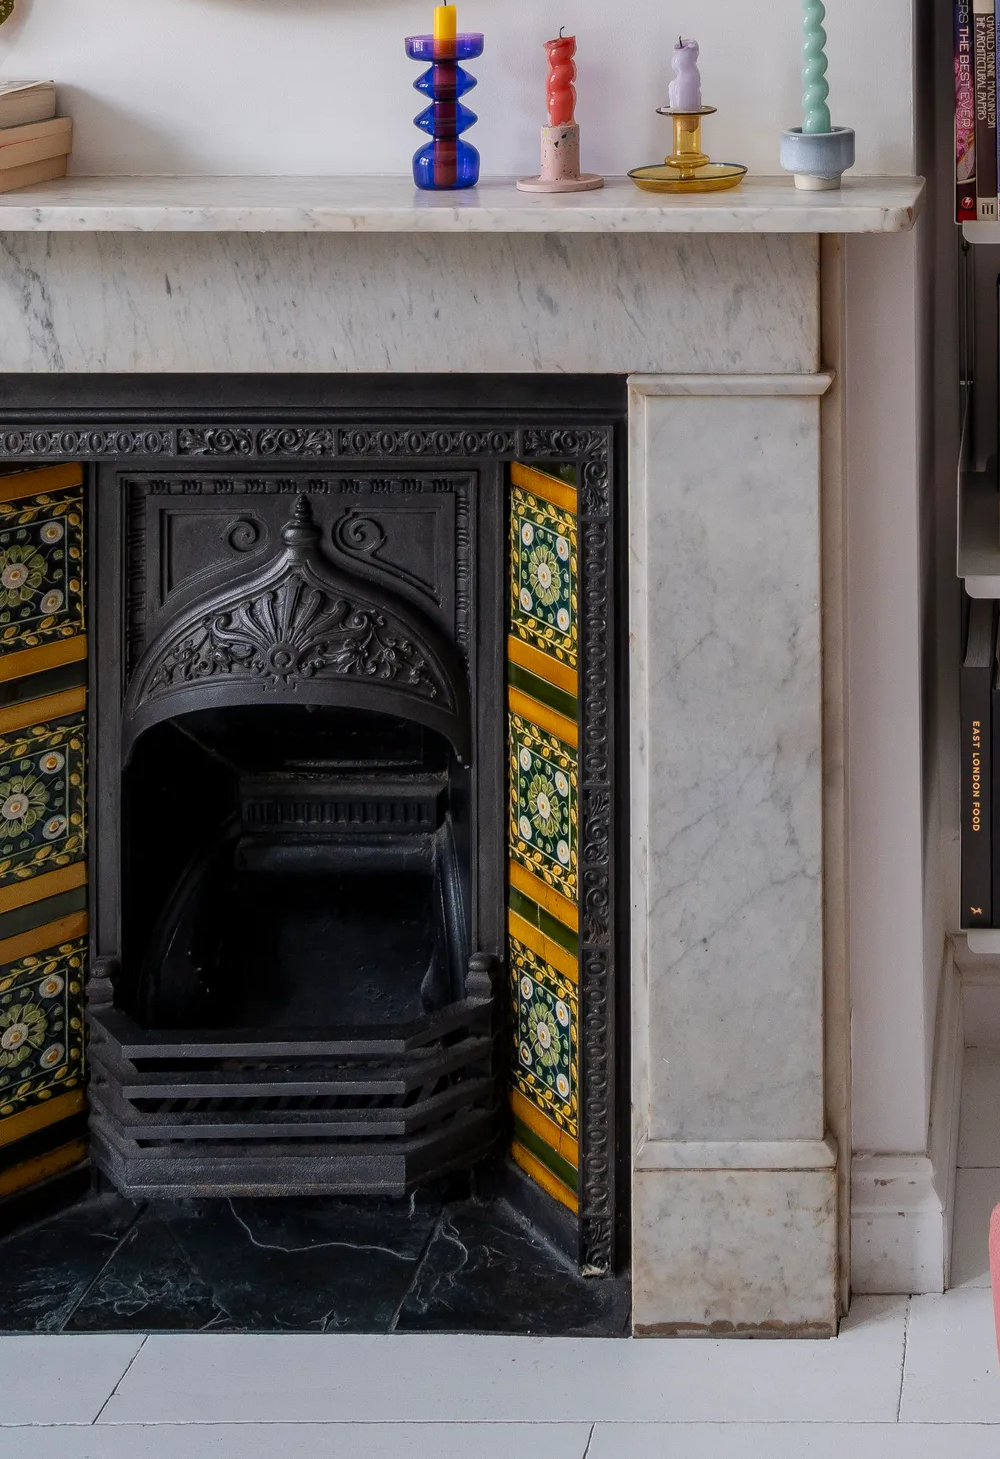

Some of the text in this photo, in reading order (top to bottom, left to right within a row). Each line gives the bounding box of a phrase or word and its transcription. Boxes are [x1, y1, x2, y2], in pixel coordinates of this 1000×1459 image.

[972, 720, 981, 832] EAST LONDON FOOD
